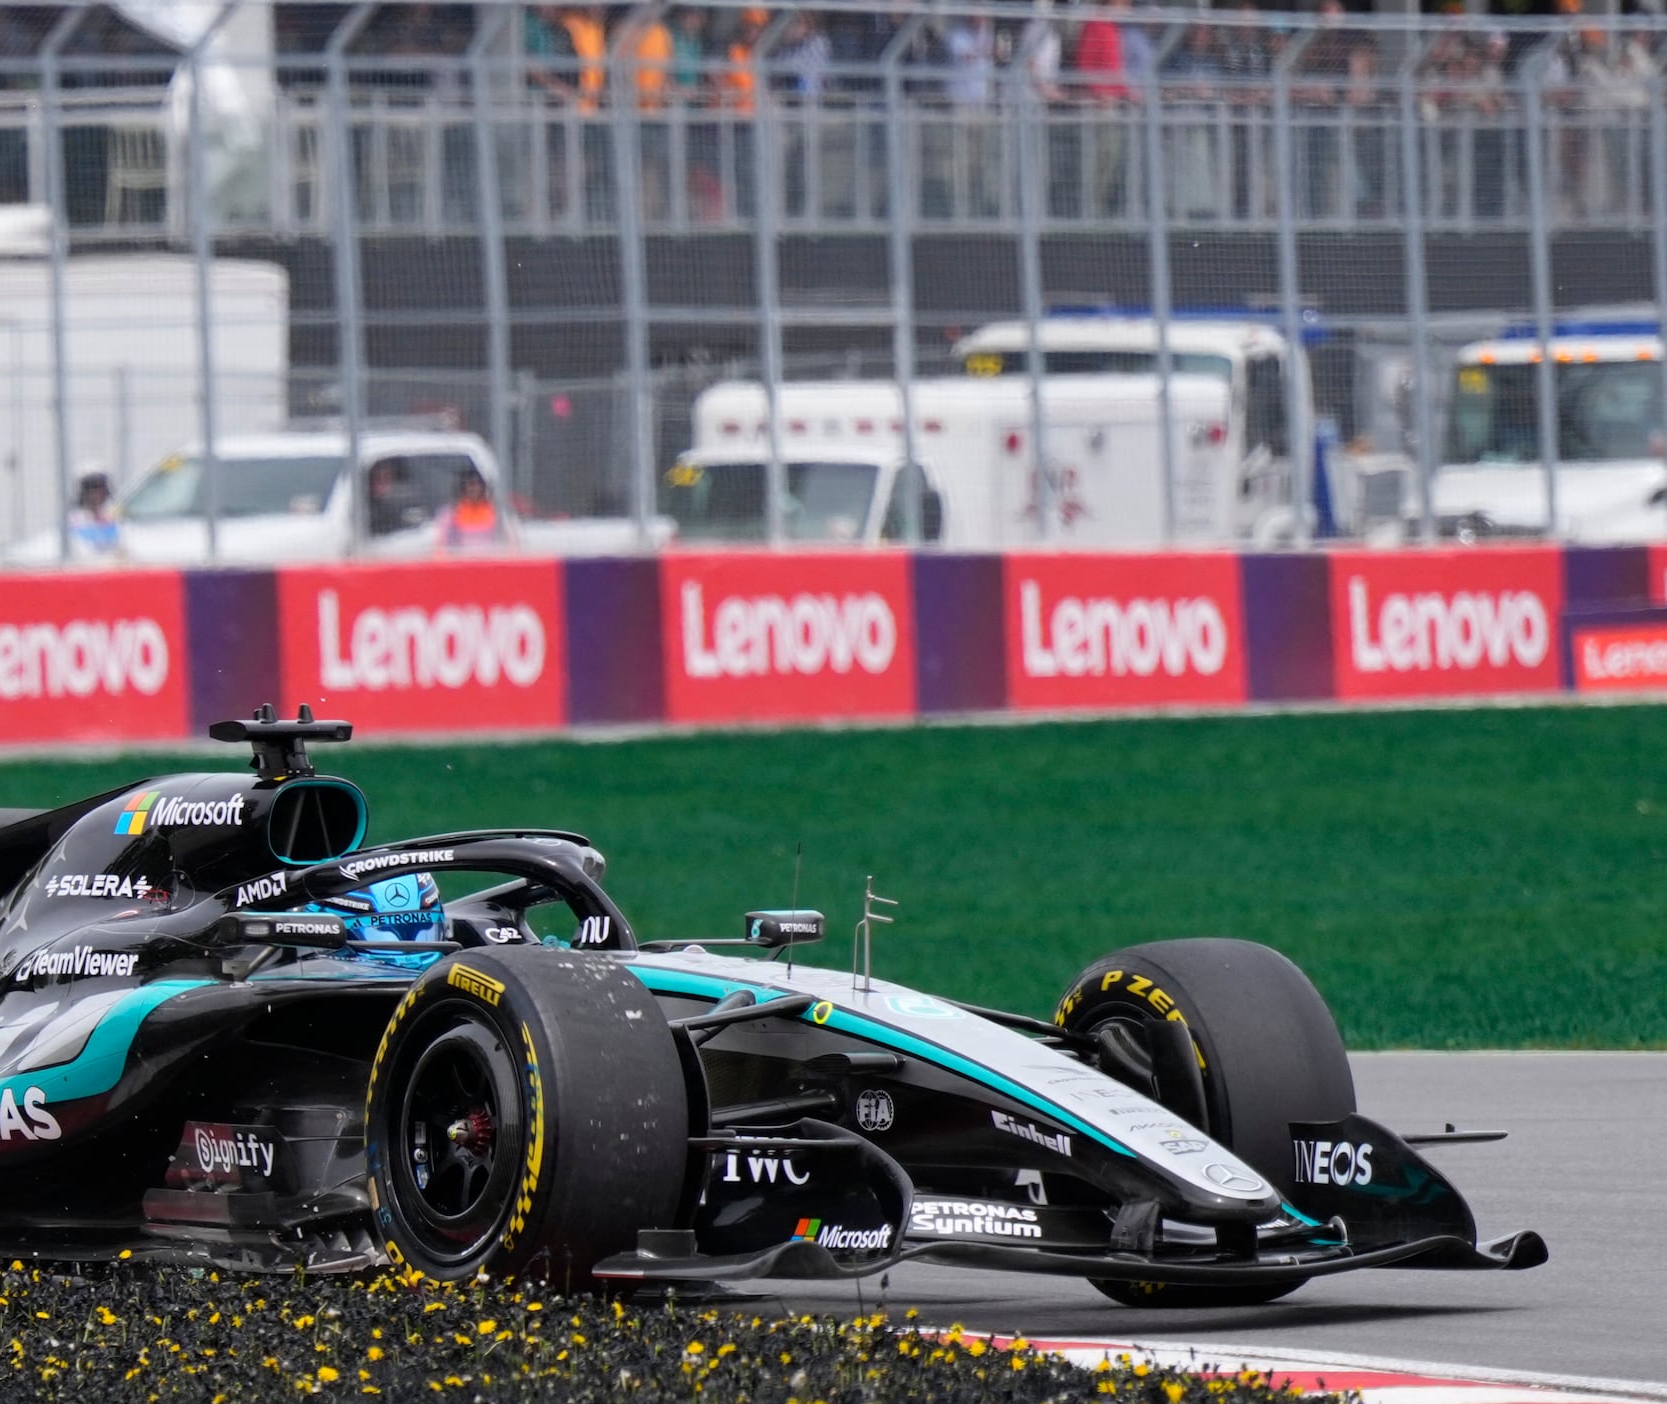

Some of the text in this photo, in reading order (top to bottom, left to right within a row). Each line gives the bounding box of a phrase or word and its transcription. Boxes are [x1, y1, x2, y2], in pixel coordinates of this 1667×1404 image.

[682, 580, 898, 678] Lenovo
[1019, 580, 1227, 676] Lenovo
[1349, 575, 1549, 671] Lenovo
[318, 591, 544, 690] Lenovo
[150, 793, 244, 825] Microsoft
[346, 850, 454, 873] CROWDSTRIKE
[58, 875, 134, 897] SOLERA
[236, 876, 273, 907] AMD
[275, 923, 340, 936] PETRONAS
[371, 912, 432, 926] PETRONAS
[779, 922, 817, 934] PETRONAS
[33, 945, 139, 977] TeamViewer
[447, 963, 506, 1007] PIRELLI
[1100, 970, 1124, 991] P
[991, 1110, 1072, 1157] Einhell
[195, 1128, 273, 1176] signify
[723, 1136, 810, 1185] IWC
[1293, 1140, 1372, 1185] INEOS
[911, 1202, 1037, 1221] PETRONAS
[912, 1214, 1042, 1238] Syntium
[817, 1224, 892, 1249] Microsoft
